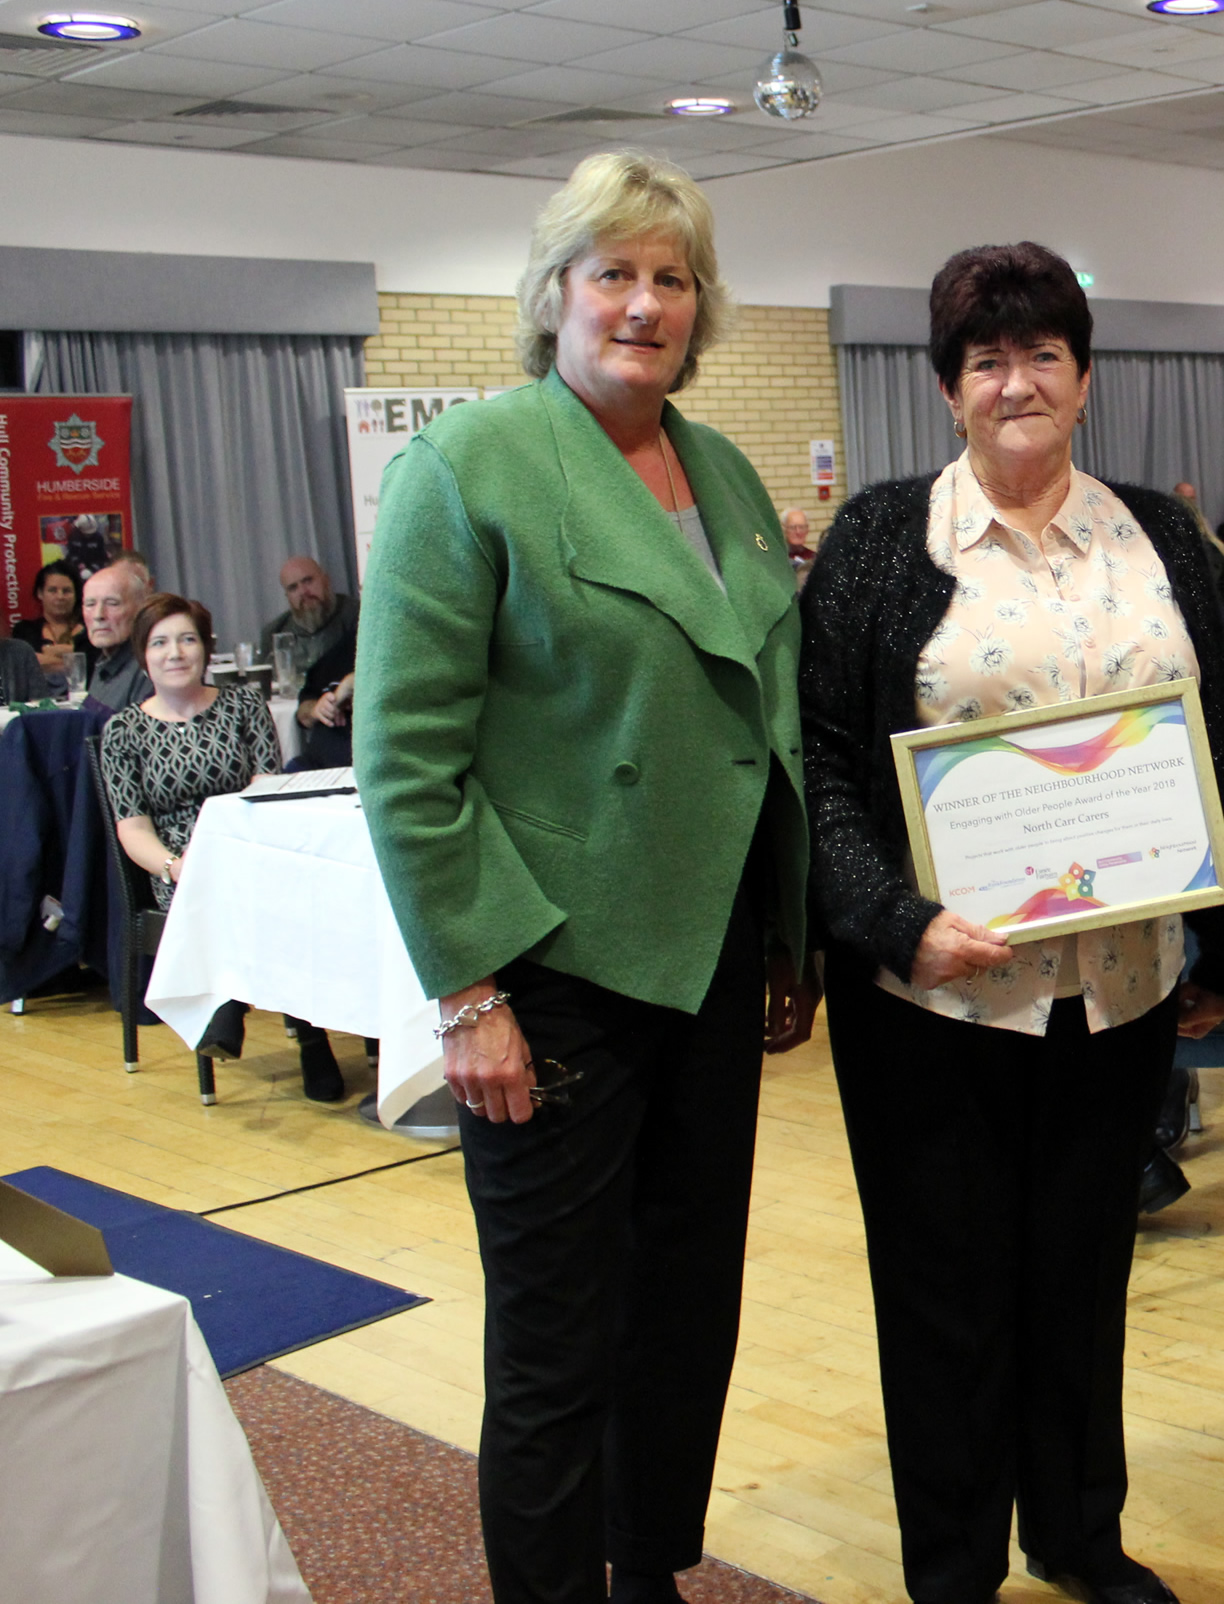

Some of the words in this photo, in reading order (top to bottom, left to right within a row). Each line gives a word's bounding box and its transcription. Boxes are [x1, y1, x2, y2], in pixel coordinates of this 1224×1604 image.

[0, 414, 9, 443] Hull
[384, 397, 469, 433] EM
[0, 447, 14, 529] Community
[37, 478, 120, 494] HUMBERSIDE
[4, 533, 20, 610] Protection
[933, 797, 980, 812] WINNER
[982, 793, 997, 803] OF
[999, 789, 1022, 800] THE
[1024, 769, 1125, 795] NEIGHBOURHOOD
[1127, 757, 1185, 775] NETWORK
[950, 817, 992, 829] Engaging
[994, 811, 1012, 821] with
[1015, 806, 1040, 817] Older
[1042, 800, 1072, 812] People
[1075, 792, 1103, 805] Award
[1105, 790, 1113, 800] of
[1116, 789, 1130, 797] the
[1131, 786, 1151, 794] Year
[1153, 779, 1175, 790] 2018
[1023, 820, 1052, 834] North
[1054, 818, 1075, 827] Carr
[1078, 812, 1109, 823] Carers
[949, 886, 976, 896] KCOM
